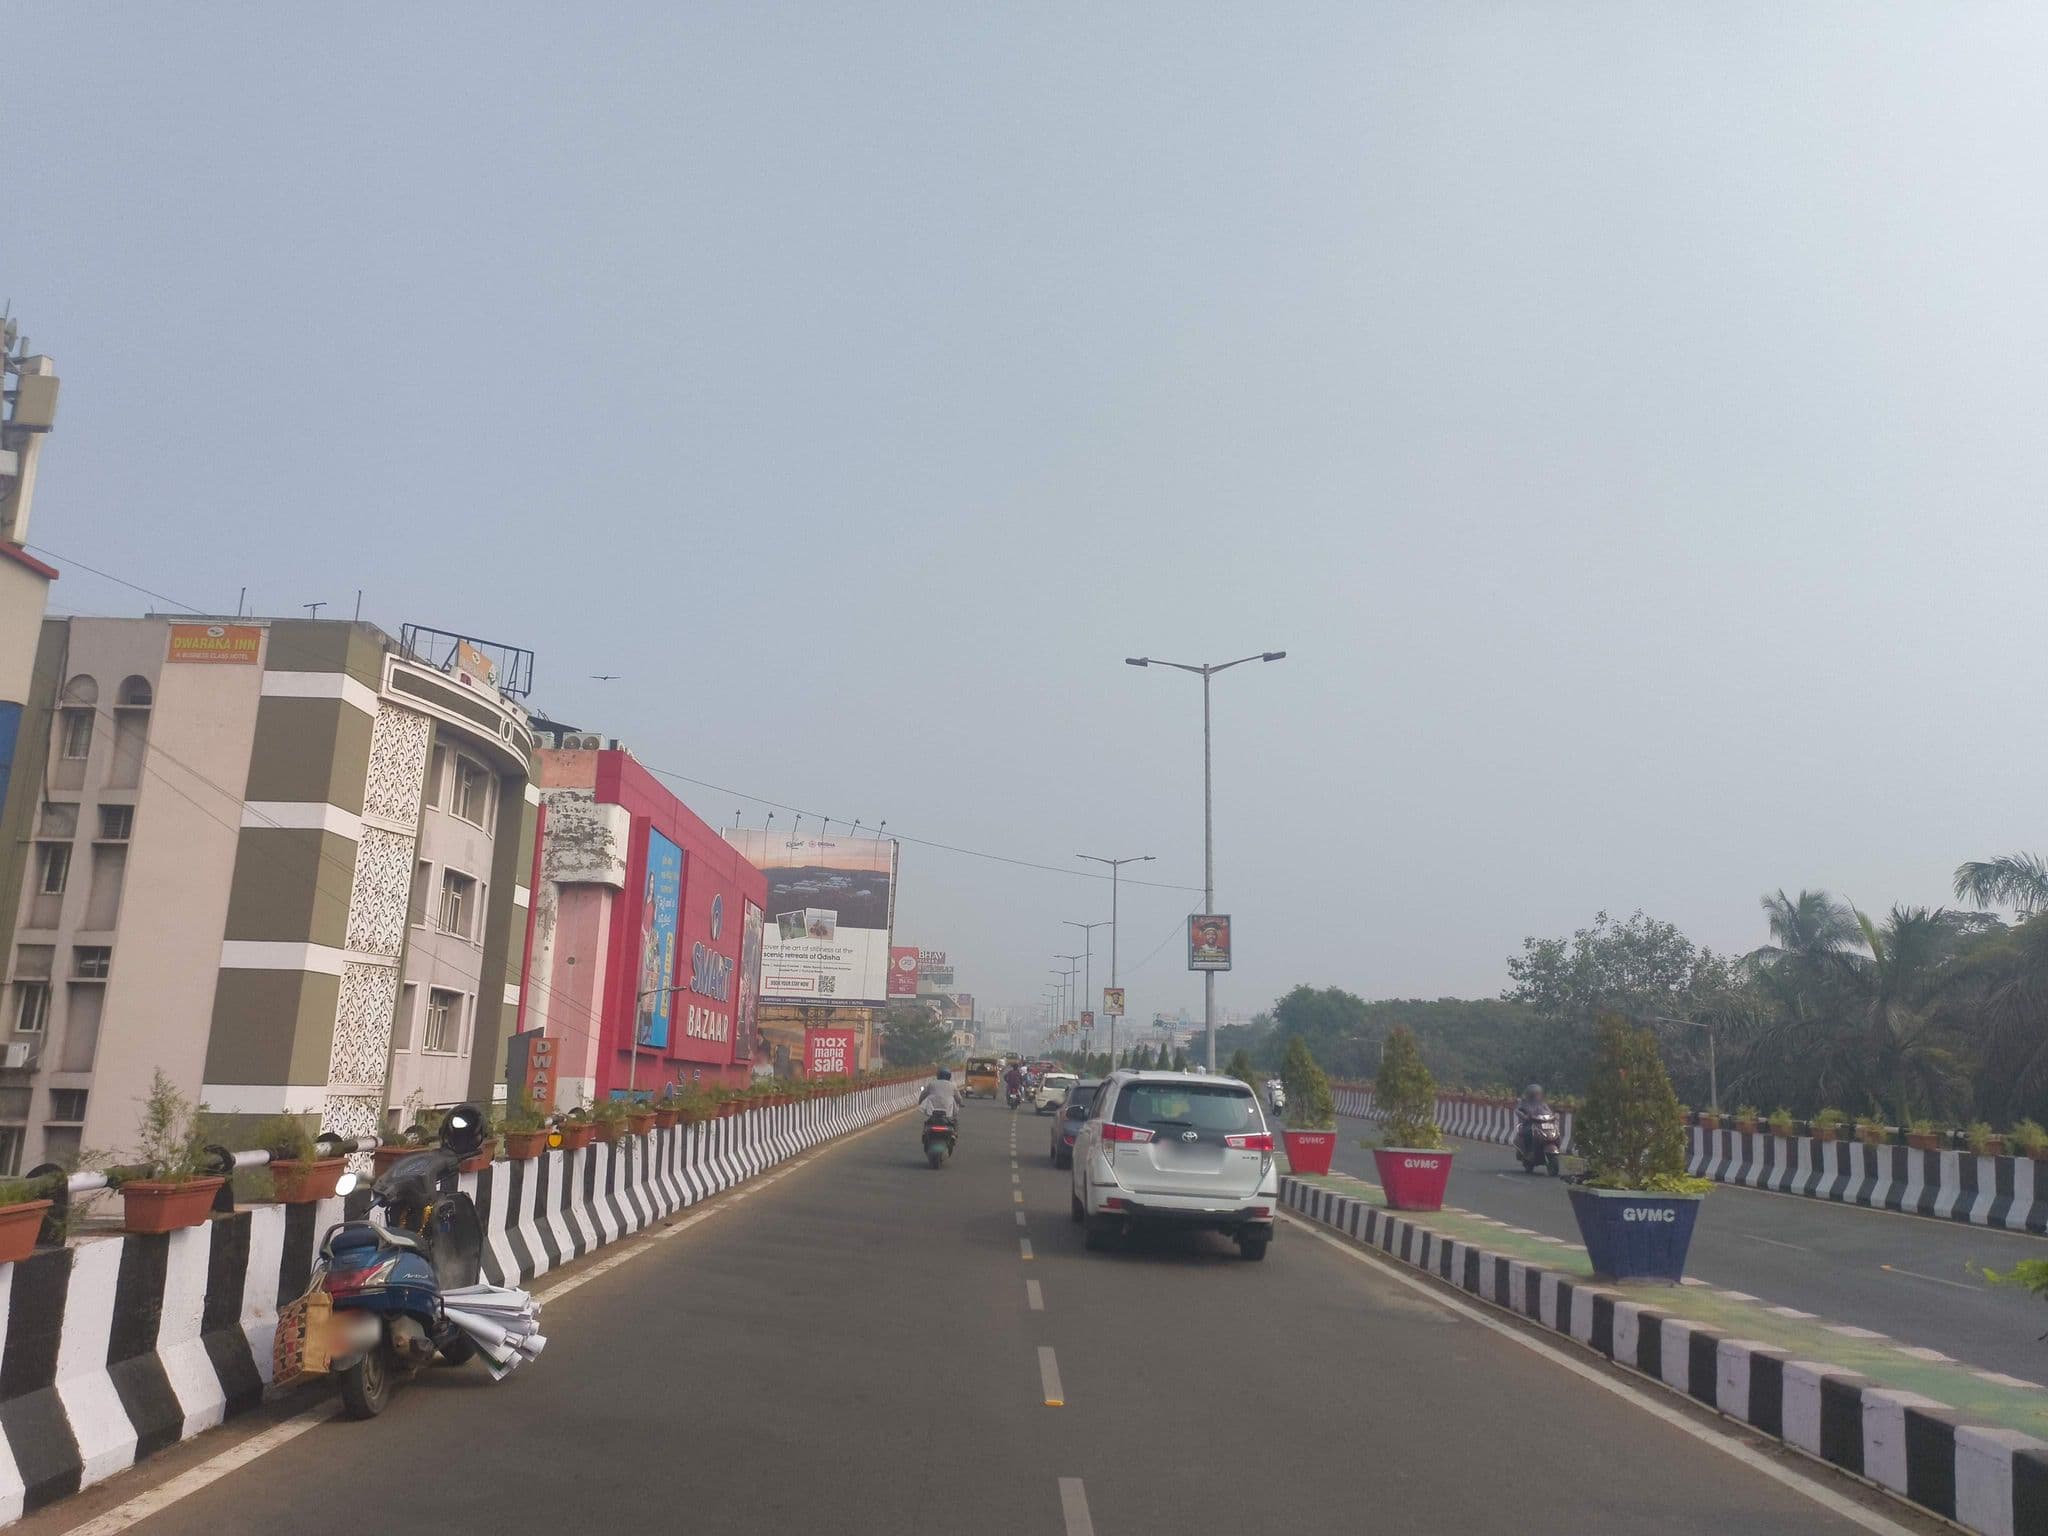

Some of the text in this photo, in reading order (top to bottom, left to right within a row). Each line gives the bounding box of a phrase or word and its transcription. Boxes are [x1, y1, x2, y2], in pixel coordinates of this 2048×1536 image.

[175, 638, 256, 651] DWARAKA INN
[764, 950, 841, 961] scenic retreats of Odisha
[690, 941, 733, 1003] SMART
[687, 1005, 728, 1043] BAZAAR
[814, 1037, 848, 1048] max
[815, 1048, 844, 1058] mania
[814, 1057, 844, 1072] sale
[1299, 1137, 1325, 1145] GVMC
[1404, 1158, 1439, 1169] GVMC
[1623, 1207, 1675, 1222] GVMC
